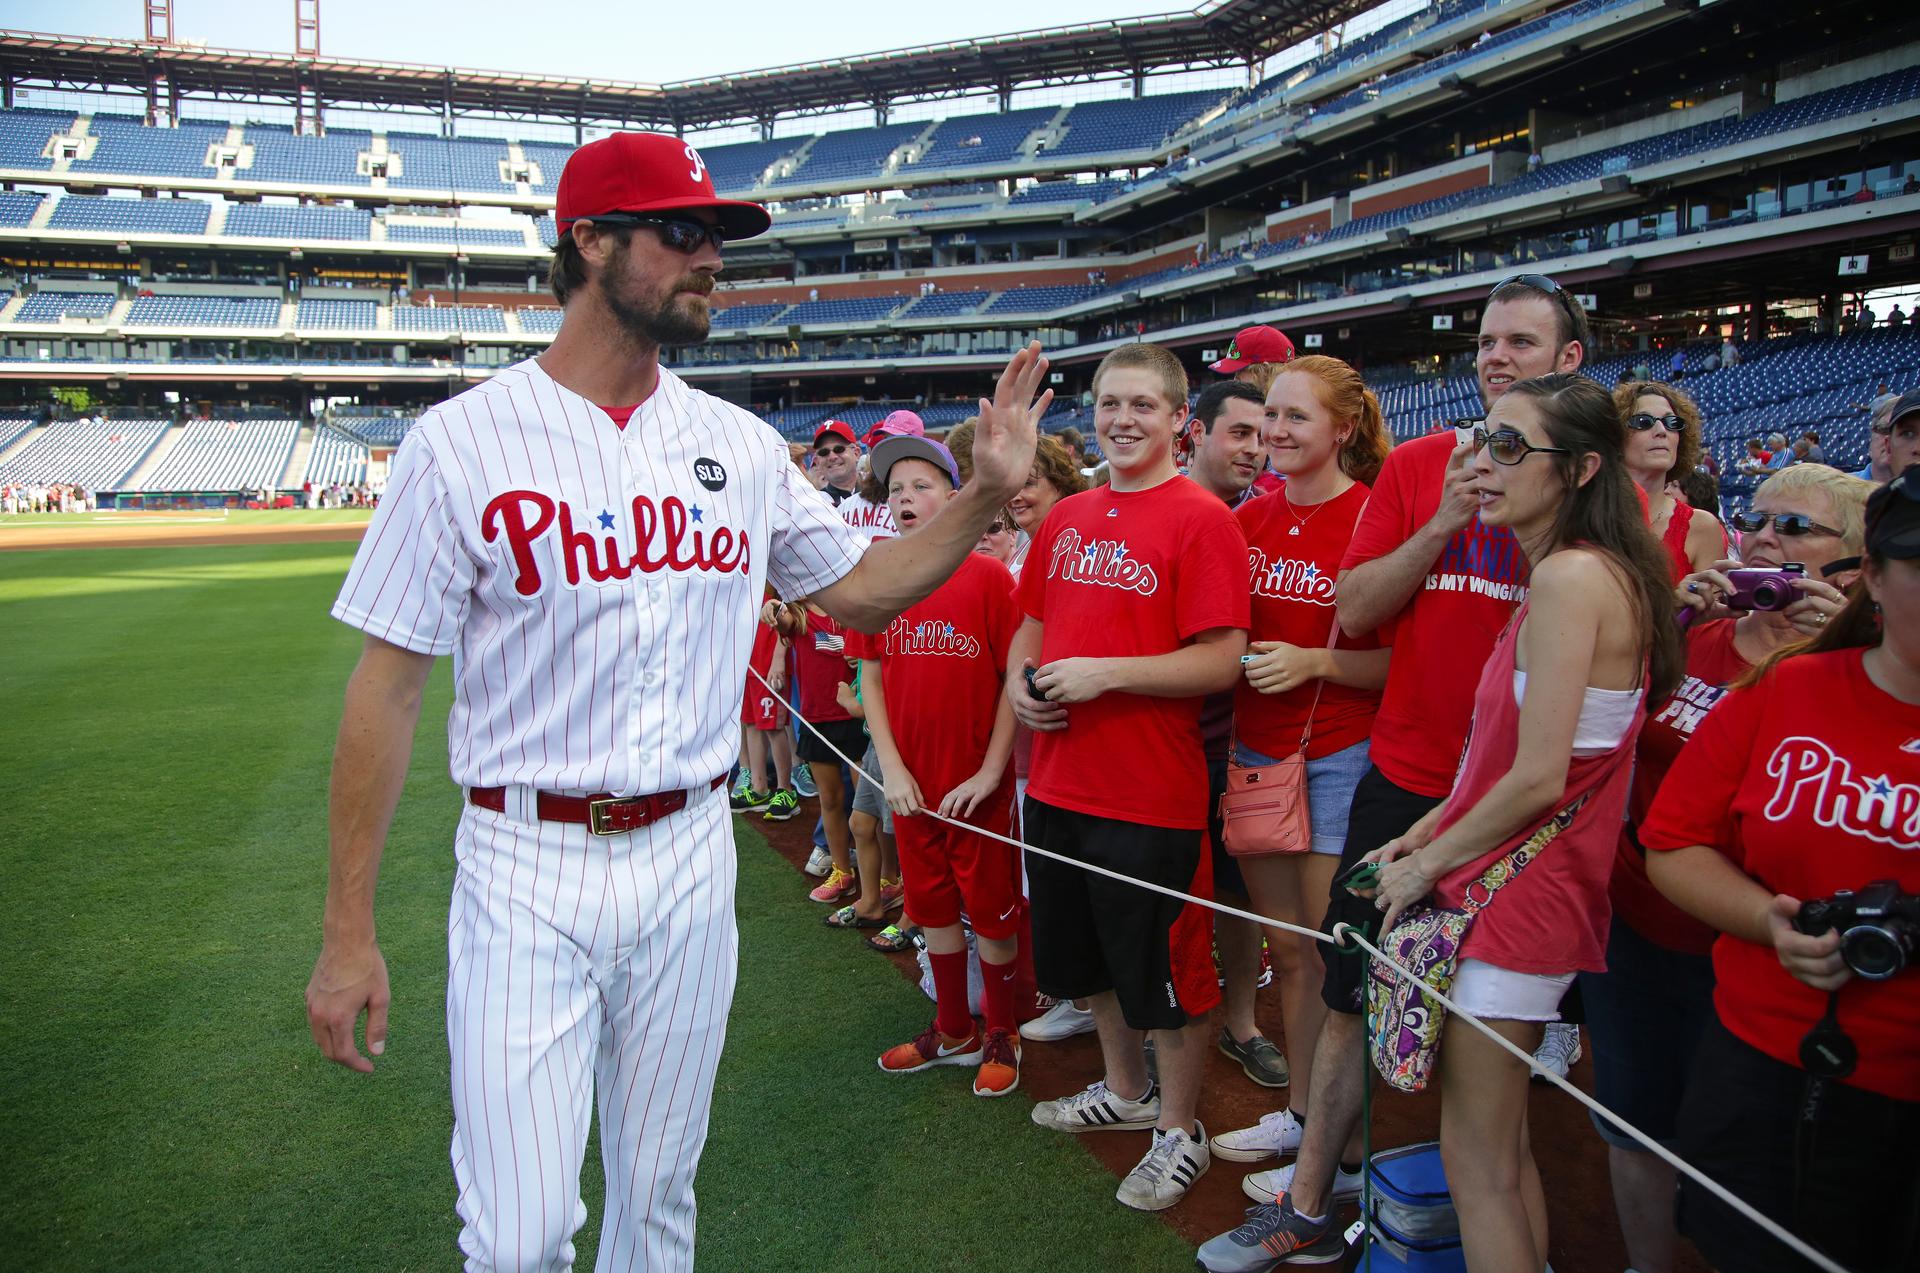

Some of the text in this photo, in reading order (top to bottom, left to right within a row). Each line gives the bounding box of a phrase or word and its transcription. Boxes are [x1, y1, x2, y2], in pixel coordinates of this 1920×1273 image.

[696, 464, 726, 482] SLB
[480, 488, 751, 597] Phillies
[1047, 527, 1158, 596] Phillies
[1247, 546, 1338, 607] Phillie
[1425, 573, 1438, 591] IS
[1438, 573, 1468, 592] MY
[881, 615, 981, 658] Phillies
[1763, 735, 1920, 849] Phil
[1165, 980, 1177, 1008] Reebok
